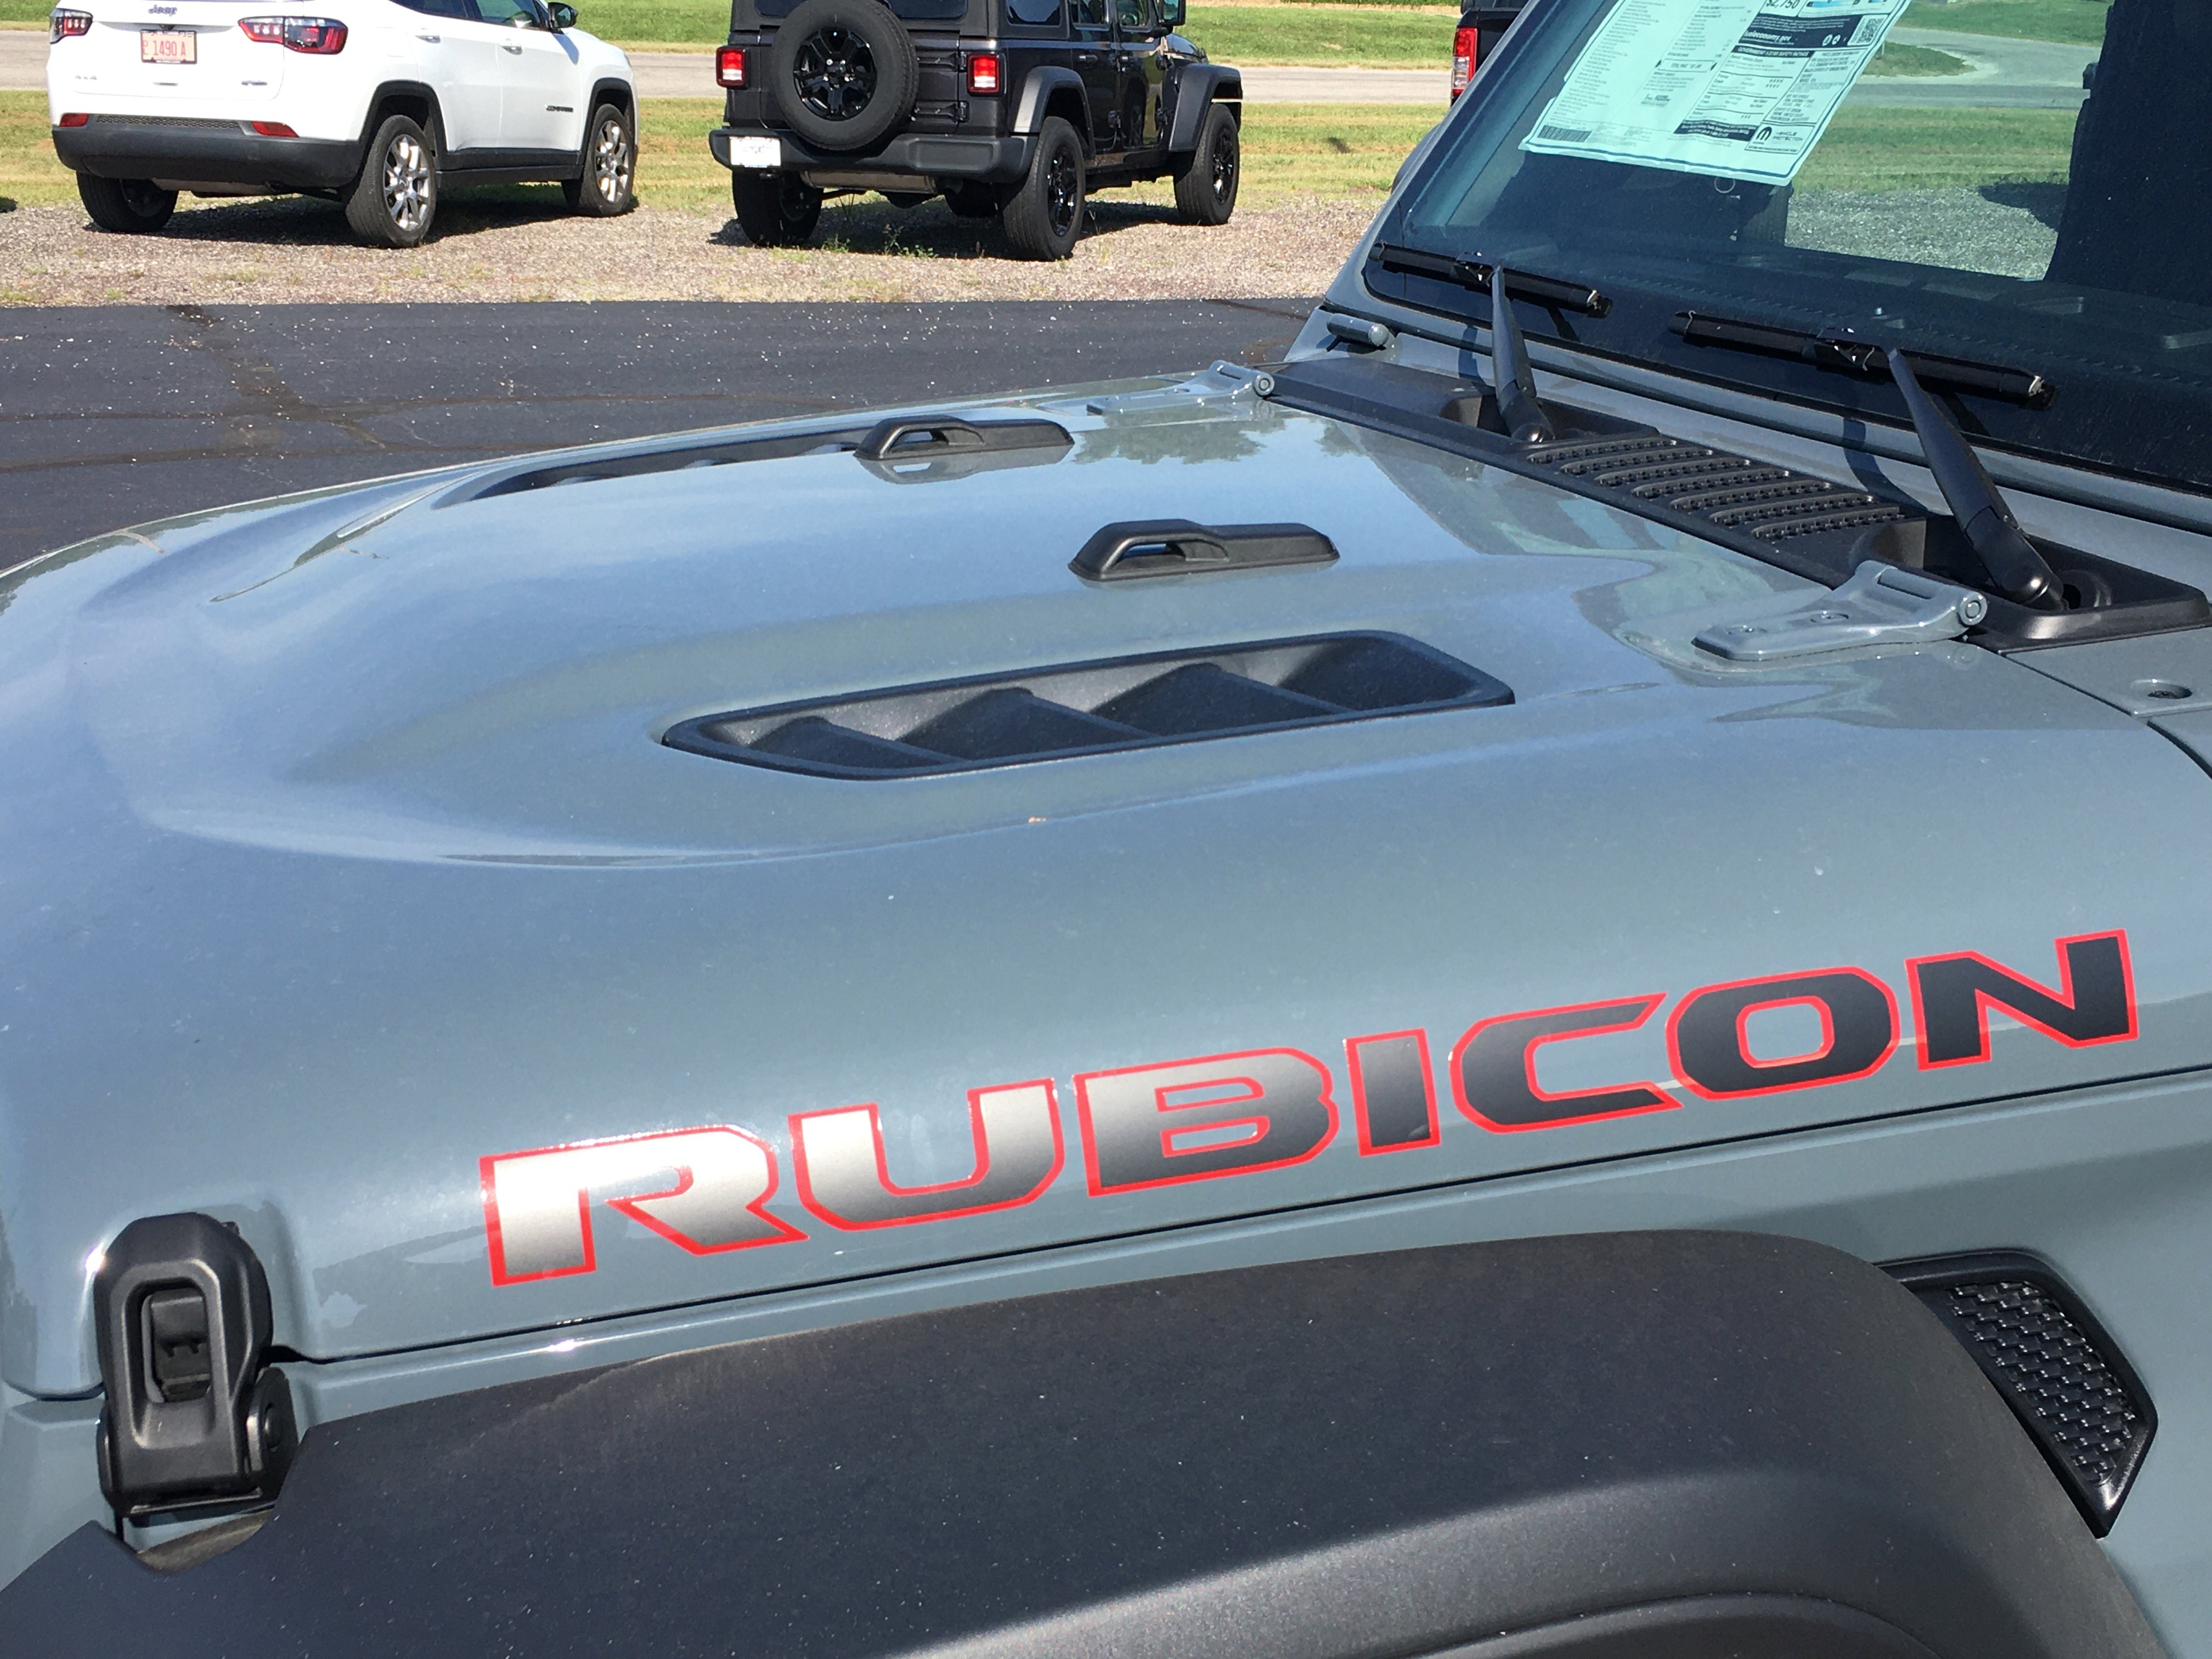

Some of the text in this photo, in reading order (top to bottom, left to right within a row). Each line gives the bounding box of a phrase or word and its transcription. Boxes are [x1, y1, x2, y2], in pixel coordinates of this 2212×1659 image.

[148, 4, 177, 16] Jeep
[153, 41, 177, 56] 1490
[181, 42, 187, 57] A
[481, 929, 2140, 1288] RUBICON
